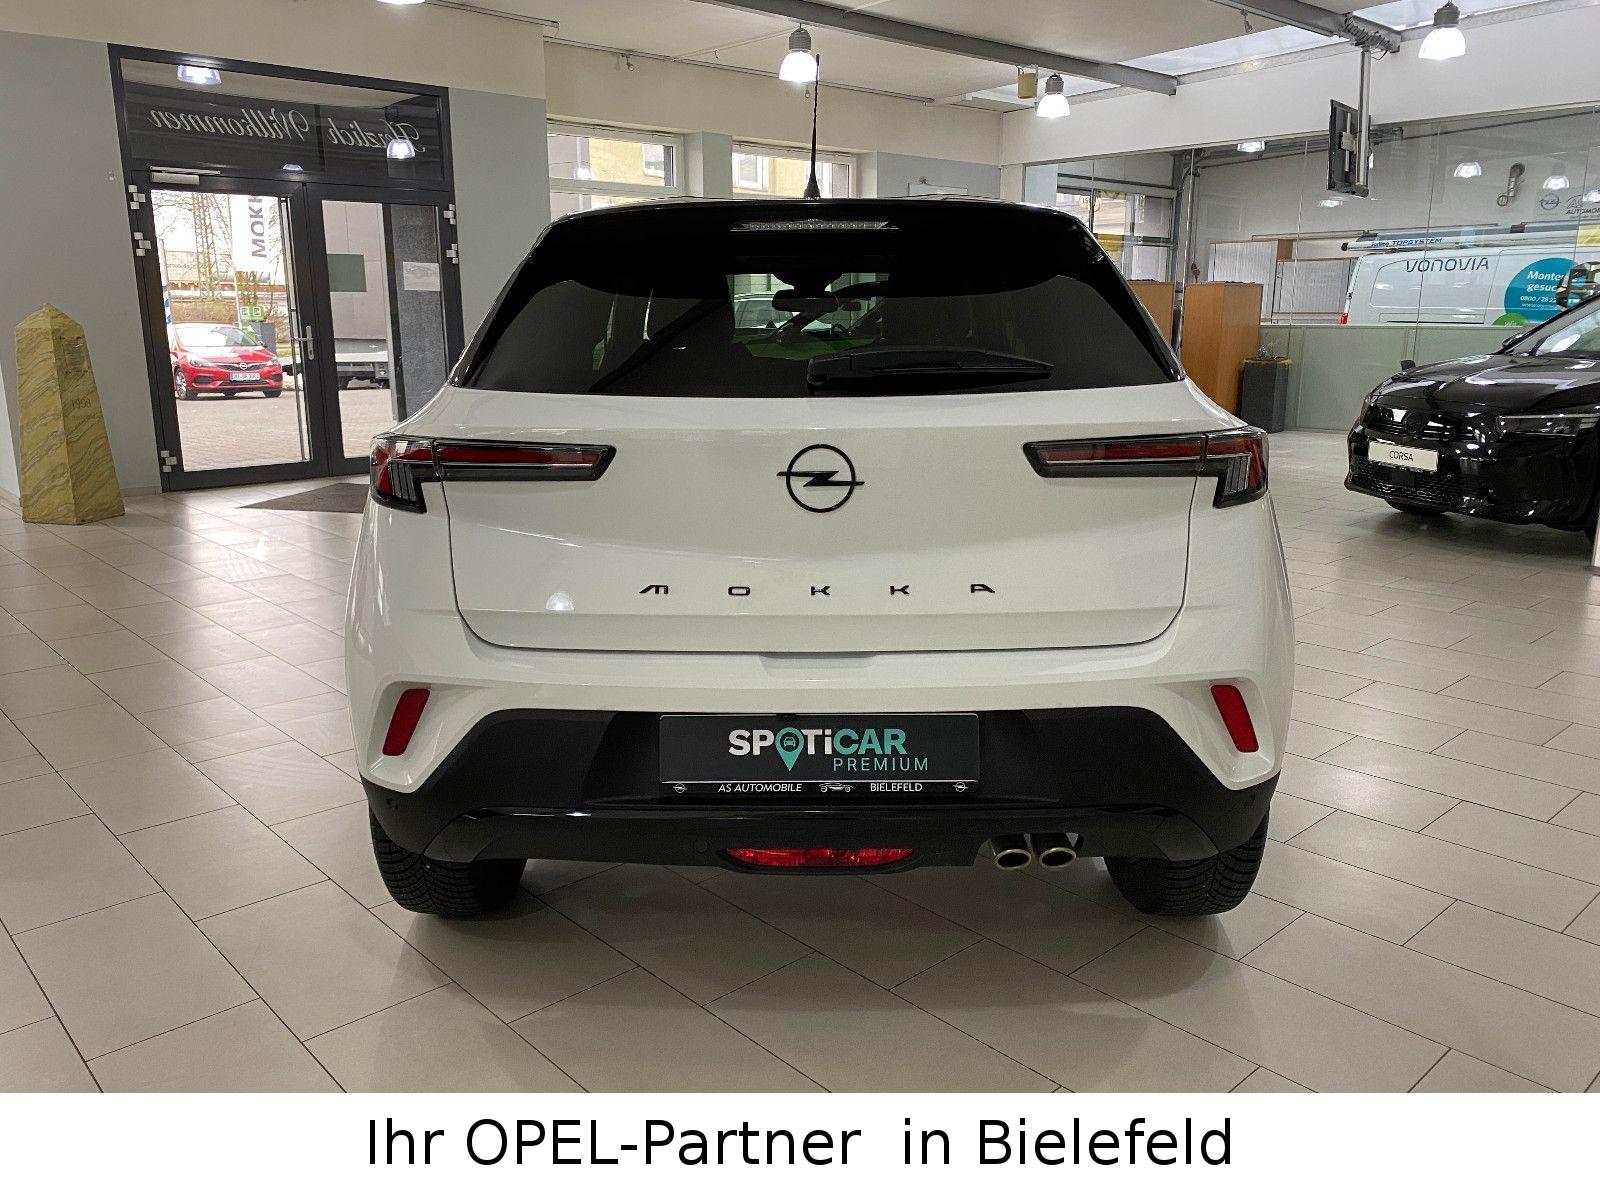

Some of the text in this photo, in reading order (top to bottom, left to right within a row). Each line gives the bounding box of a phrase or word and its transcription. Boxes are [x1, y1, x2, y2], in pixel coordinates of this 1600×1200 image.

[1392, 238, 1443, 247] TOPSYSTEM
[1389, 450, 1414, 462] CORSA
[639, 583, 996, 596] MOKKA
[833, 757, 929, 772] PREMIUM
[717, 782, 923, 793] AS AUTOMOBILE BIELEFELD
